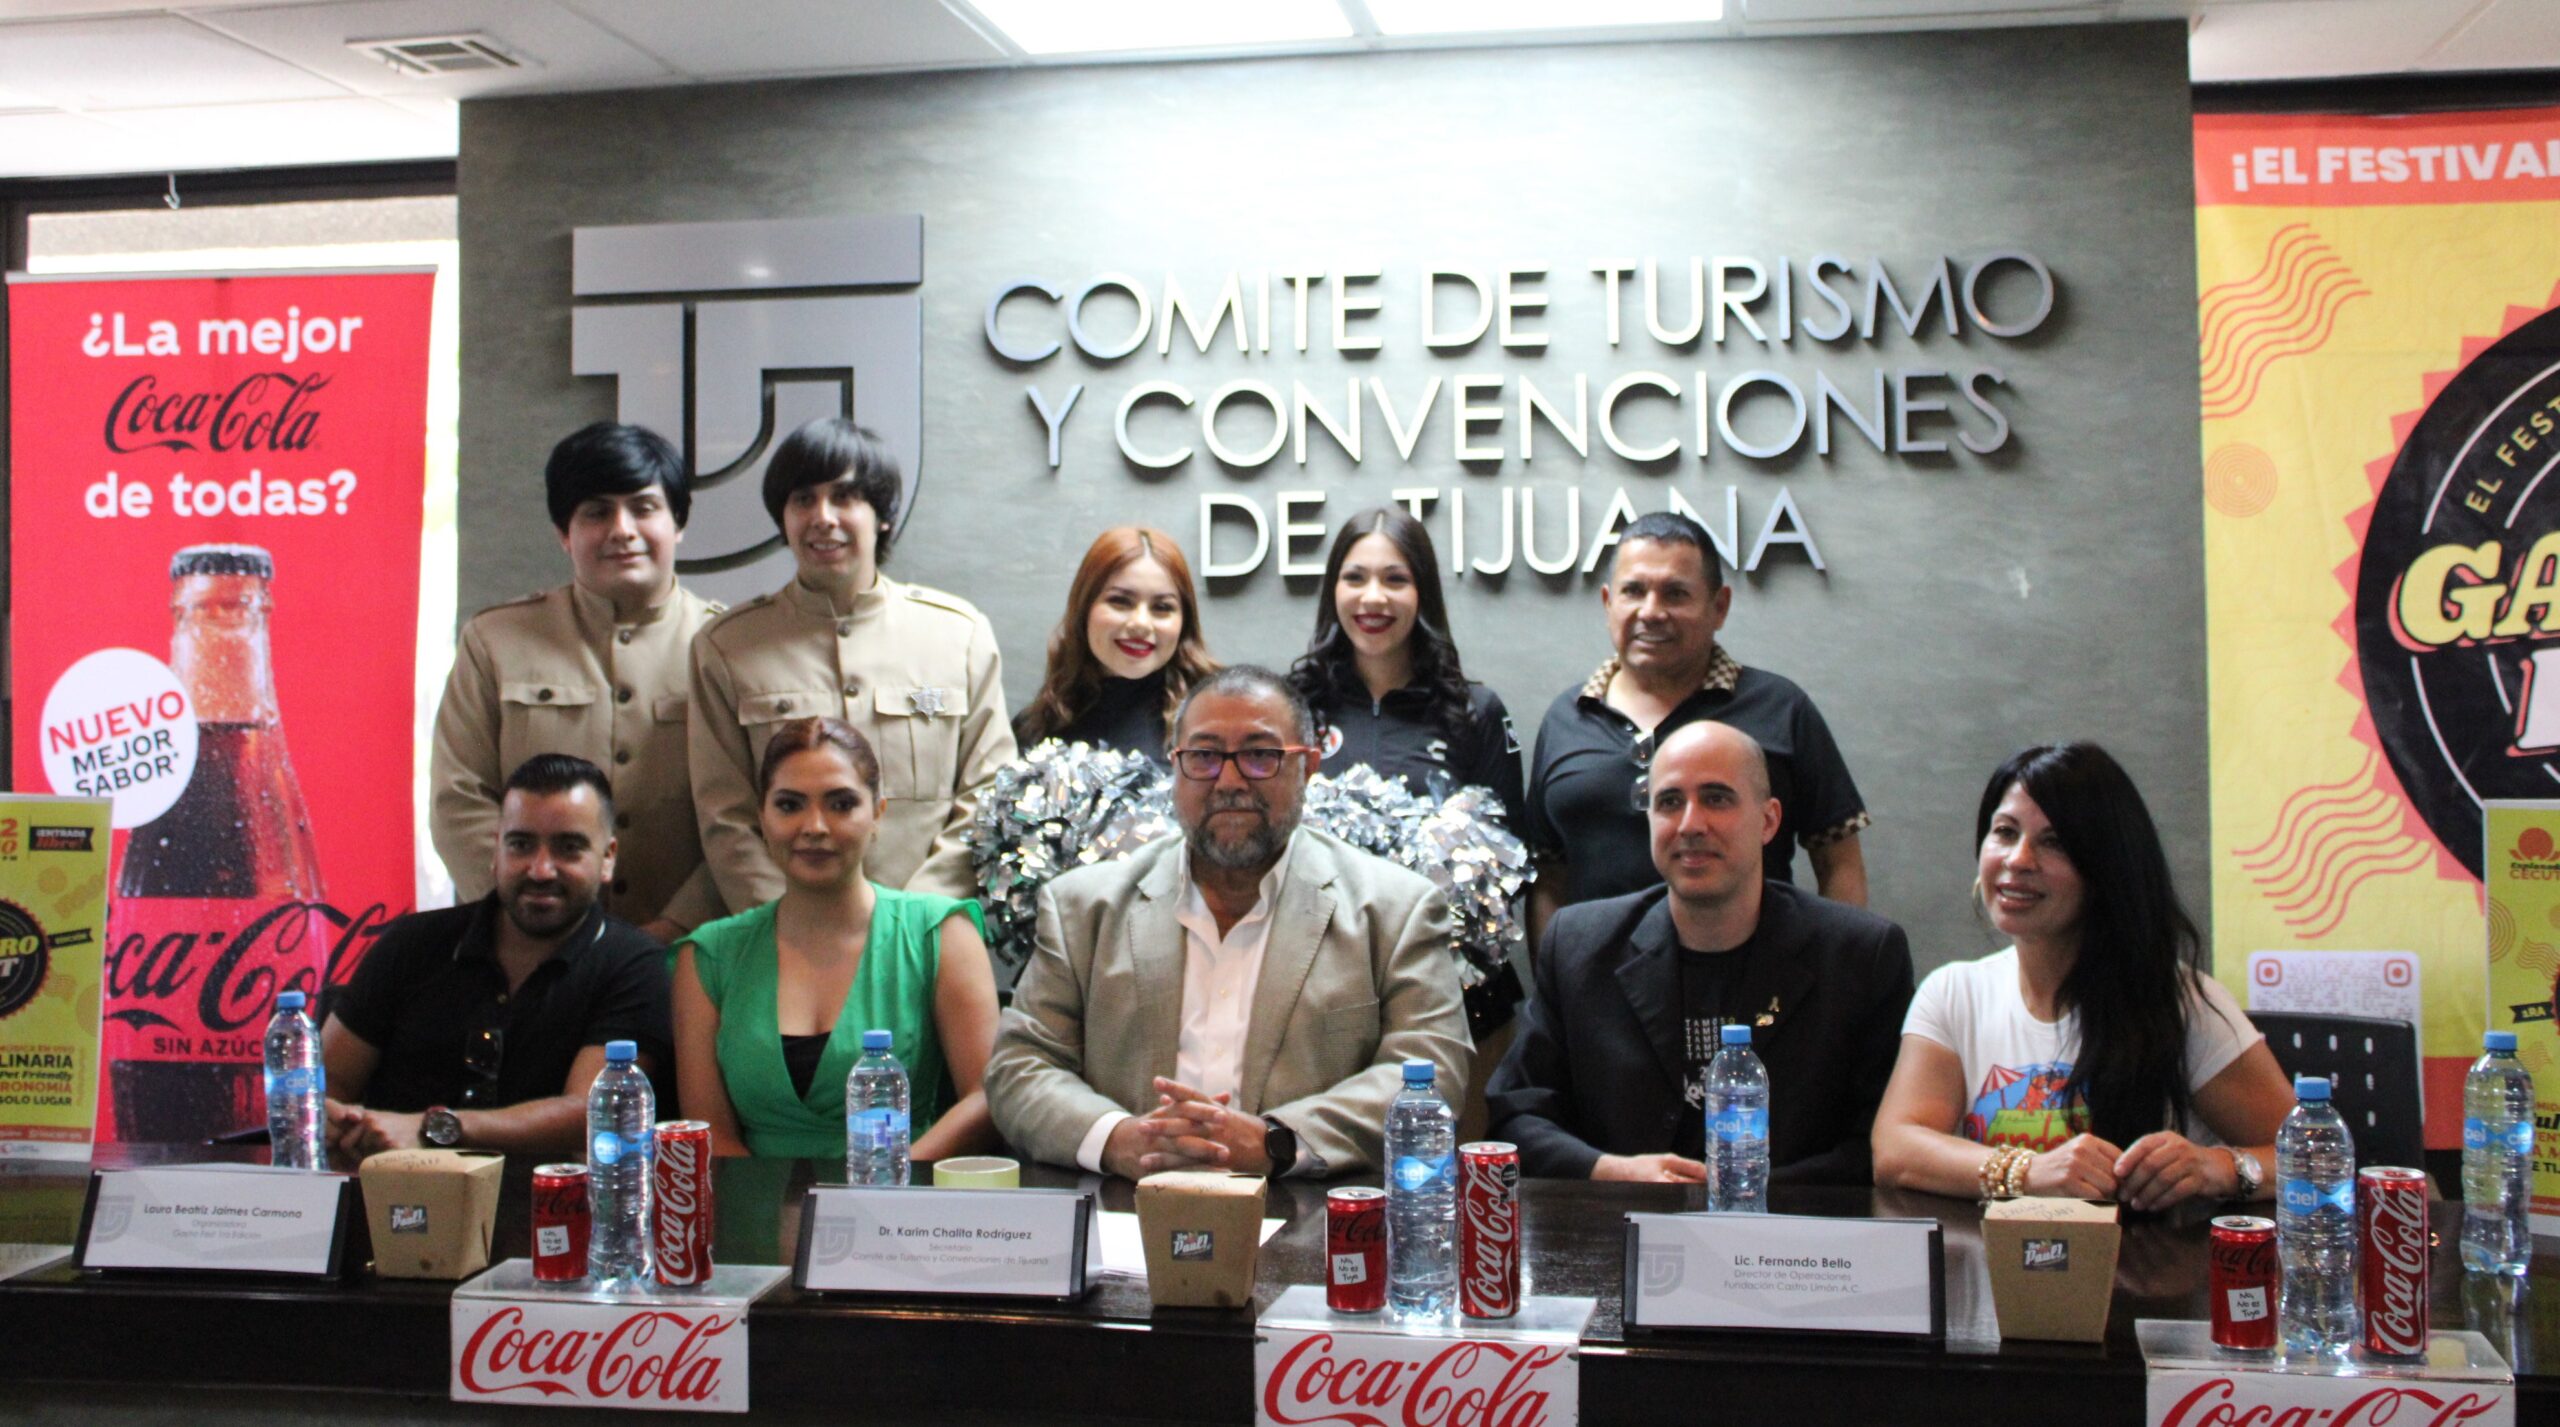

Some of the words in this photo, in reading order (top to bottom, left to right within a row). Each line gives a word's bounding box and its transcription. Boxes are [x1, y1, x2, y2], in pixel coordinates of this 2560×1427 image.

[2232, 146, 2309, 192] ¡EL
[983, 268, 1384, 363] COMITE
[1422, 261, 1549, 350] DE
[1590, 252, 2055, 347] TURISMO
[81, 312, 180, 358] ¿La
[198, 306, 363, 363] mejor
[1026, 384, 1083, 468] Y
[1114, 368, 2011, 470] CONVENCIONES
[84, 471, 153, 518] de
[168, 469, 358, 518] todas?
[2464, 479, 2503, 513] EL
[1200, 490, 1326, 578] DE
[48, 691, 184, 754] NUEVO
[72, 729, 173, 775] MEJOR
[153, 1038, 192, 1055] SIN
[199, 1035, 263, 1057] AZÚC
[1715, 1119, 1741, 1133] ciel
[1395, 1166, 1424, 1181] ciel
[144, 1204, 172, 1214] Laura
[211, 1206, 249, 1216] Jaimes
[2286, 1191, 2318, 1206] ciel
[878, 1226, 893, 1237] Dr.
[897, 1226, 929, 1238] Karim
[932, 1227, 972, 1239] Chalita
[976, 1228, 1032, 1241] Rodríguez
[1734, 1255, 1754, 1266] Lic.
[1758, 1255, 1818, 1268] Fernando
[1821, 1257, 1852, 1269] Bello
[1734, 1269, 1772, 1279] Director
[1774, 1269, 1787, 1279] de
[1790, 1271, 1852, 1282] Operaciones
[1724, 1280, 1774, 1290] Fundación
